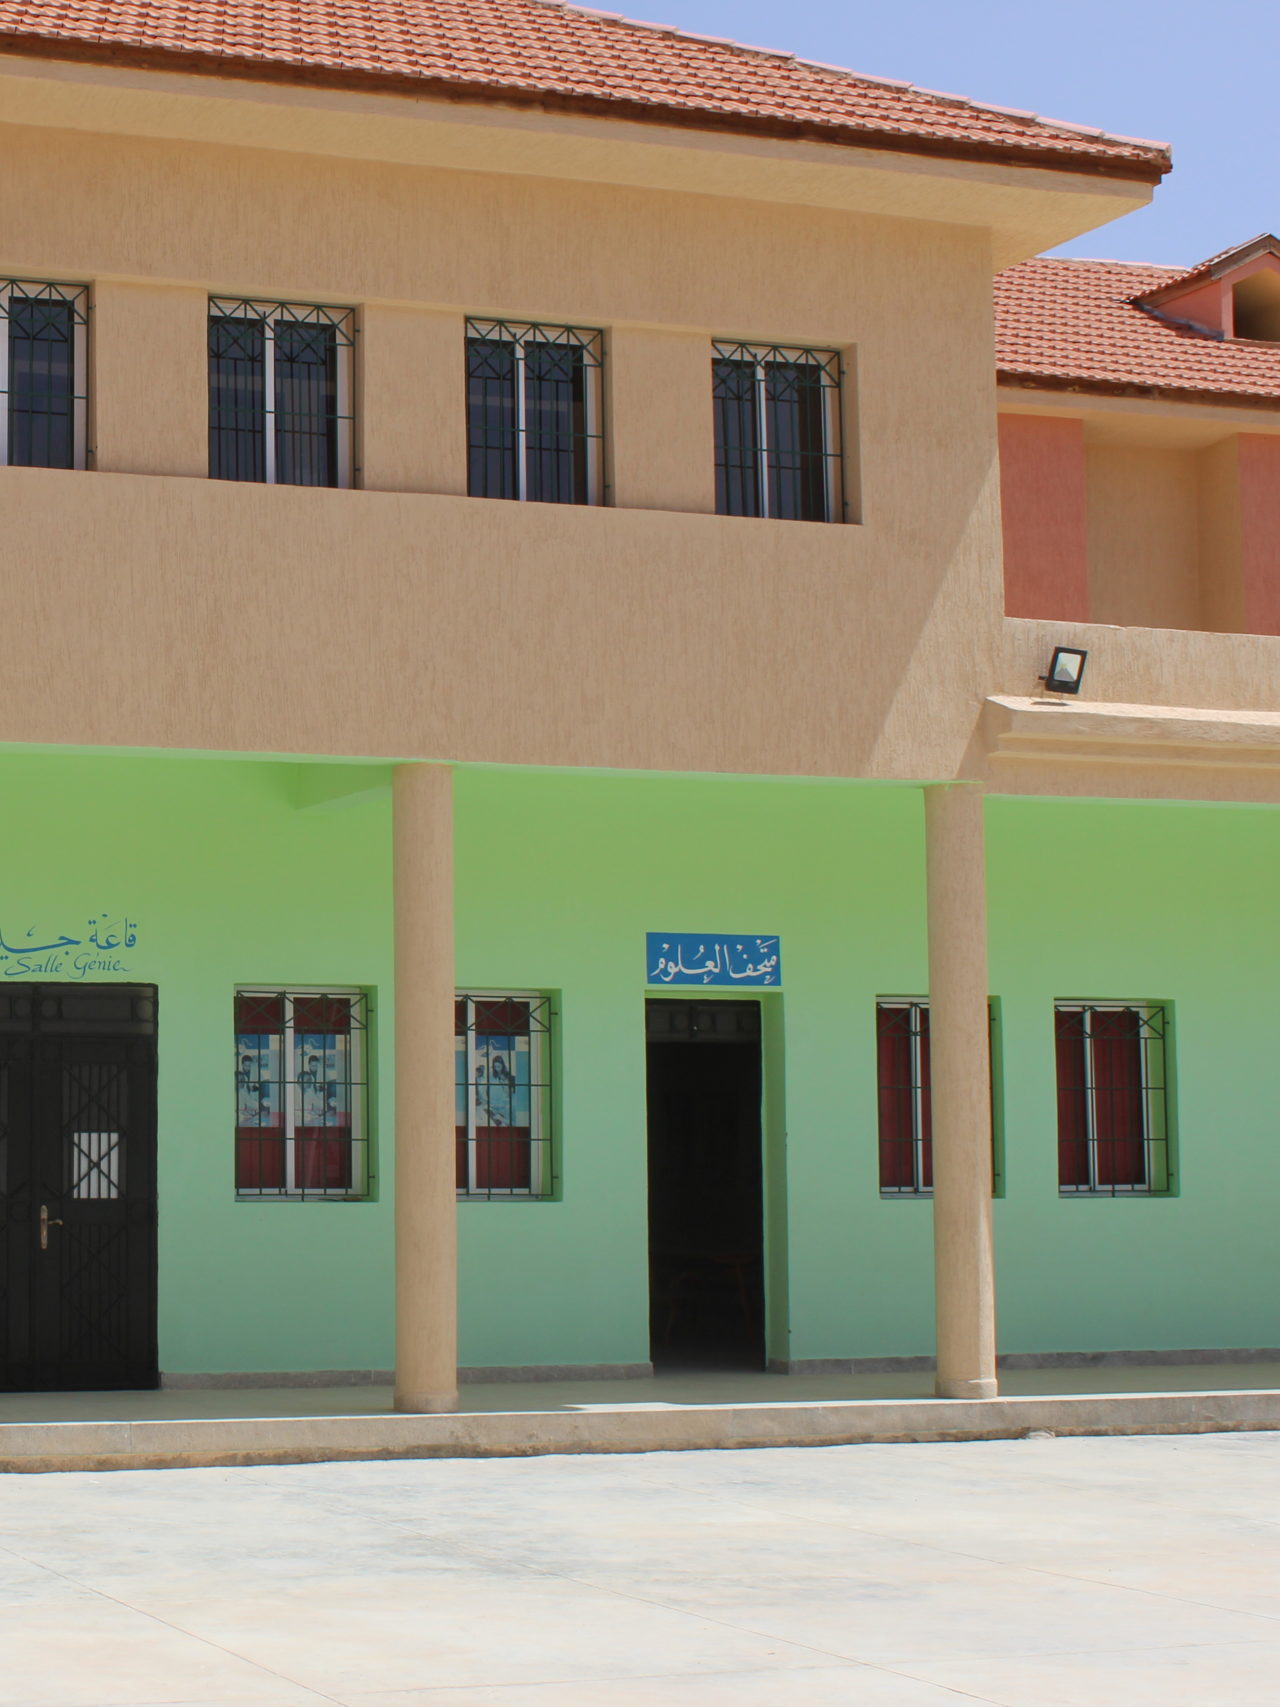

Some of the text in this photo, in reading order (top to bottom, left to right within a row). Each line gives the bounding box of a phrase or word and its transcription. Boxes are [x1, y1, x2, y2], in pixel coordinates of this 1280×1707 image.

[87, 913, 138, 950] قاعة
[4, 953, 64, 976] Salle
[649, 938, 778, 985] متحف العلوم
